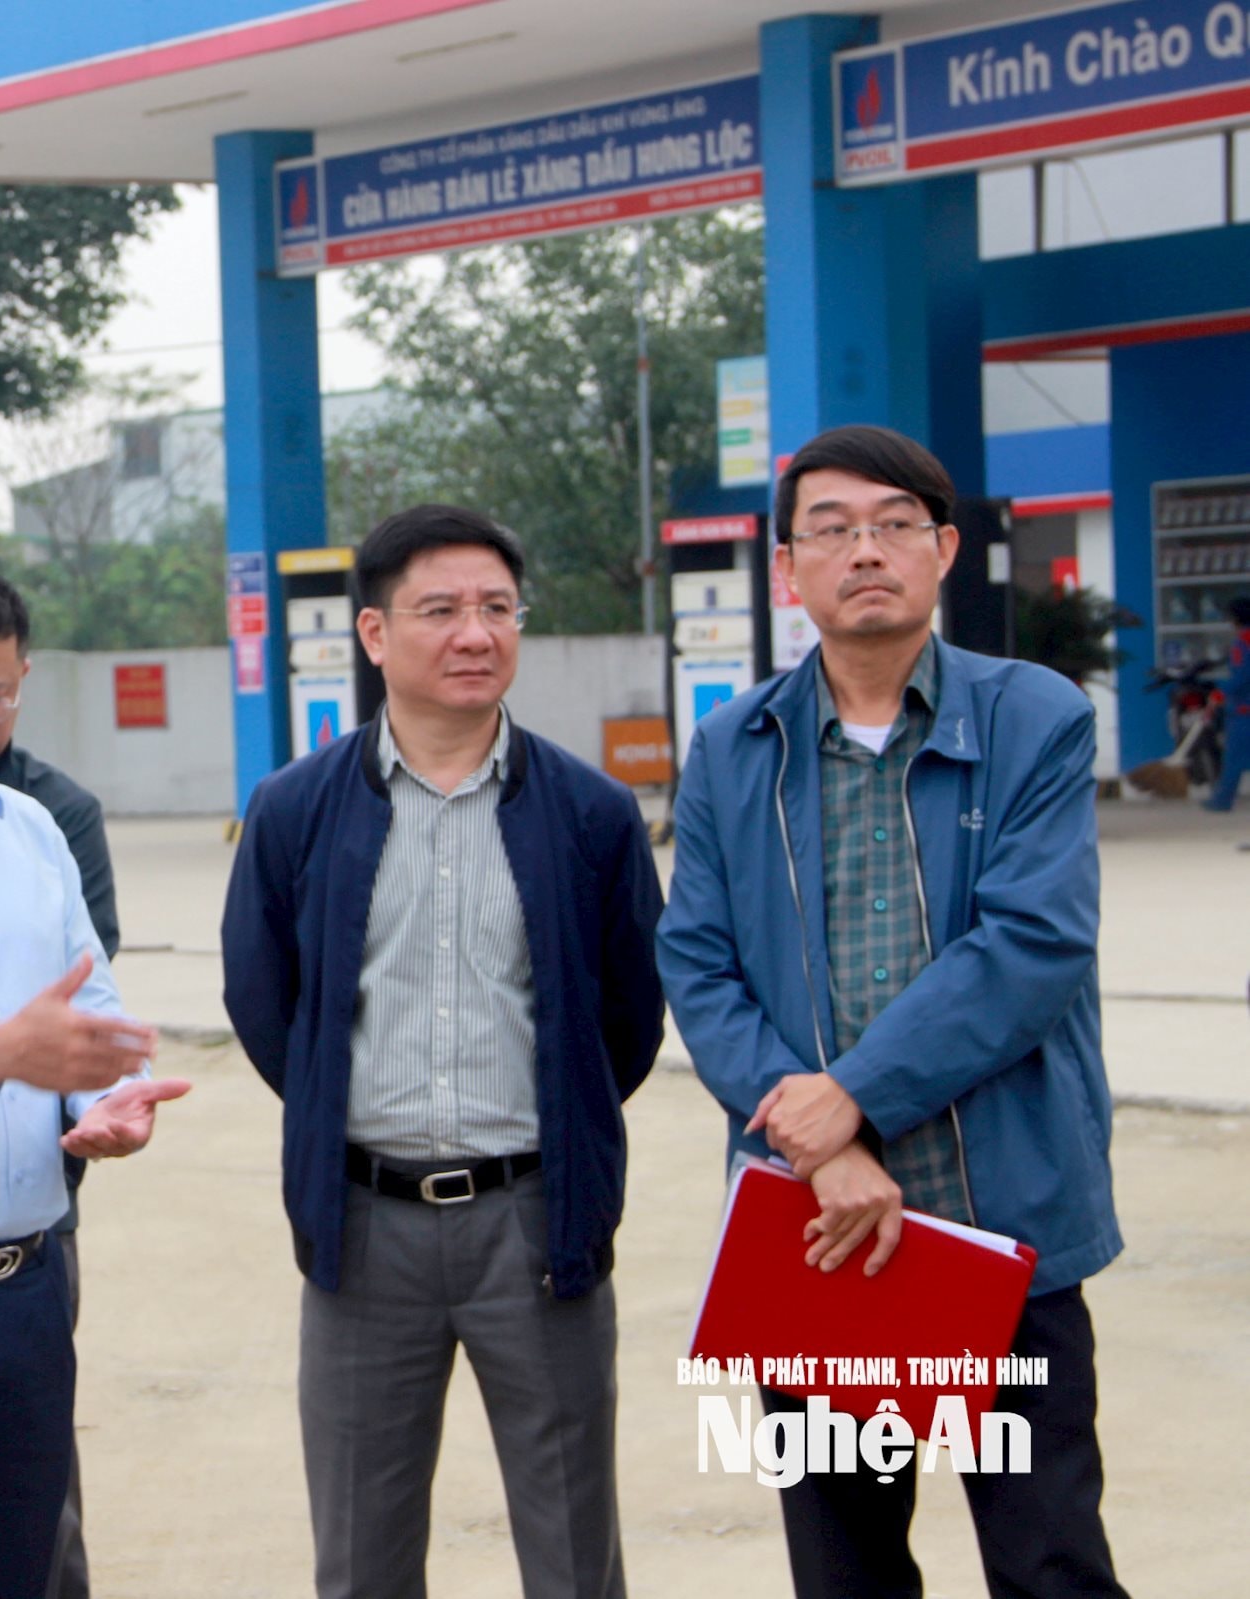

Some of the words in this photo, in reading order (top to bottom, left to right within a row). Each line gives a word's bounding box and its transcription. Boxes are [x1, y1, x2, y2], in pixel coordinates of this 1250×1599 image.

[949, 41, 1050, 107] Kính
[1065, 19, 1192, 85] Chào
[385, 178, 442, 221] HÀNG
[444, 167, 490, 211] BÁN
[492, 155, 518, 203] LẺ
[705, 118, 754, 170] LỘC
